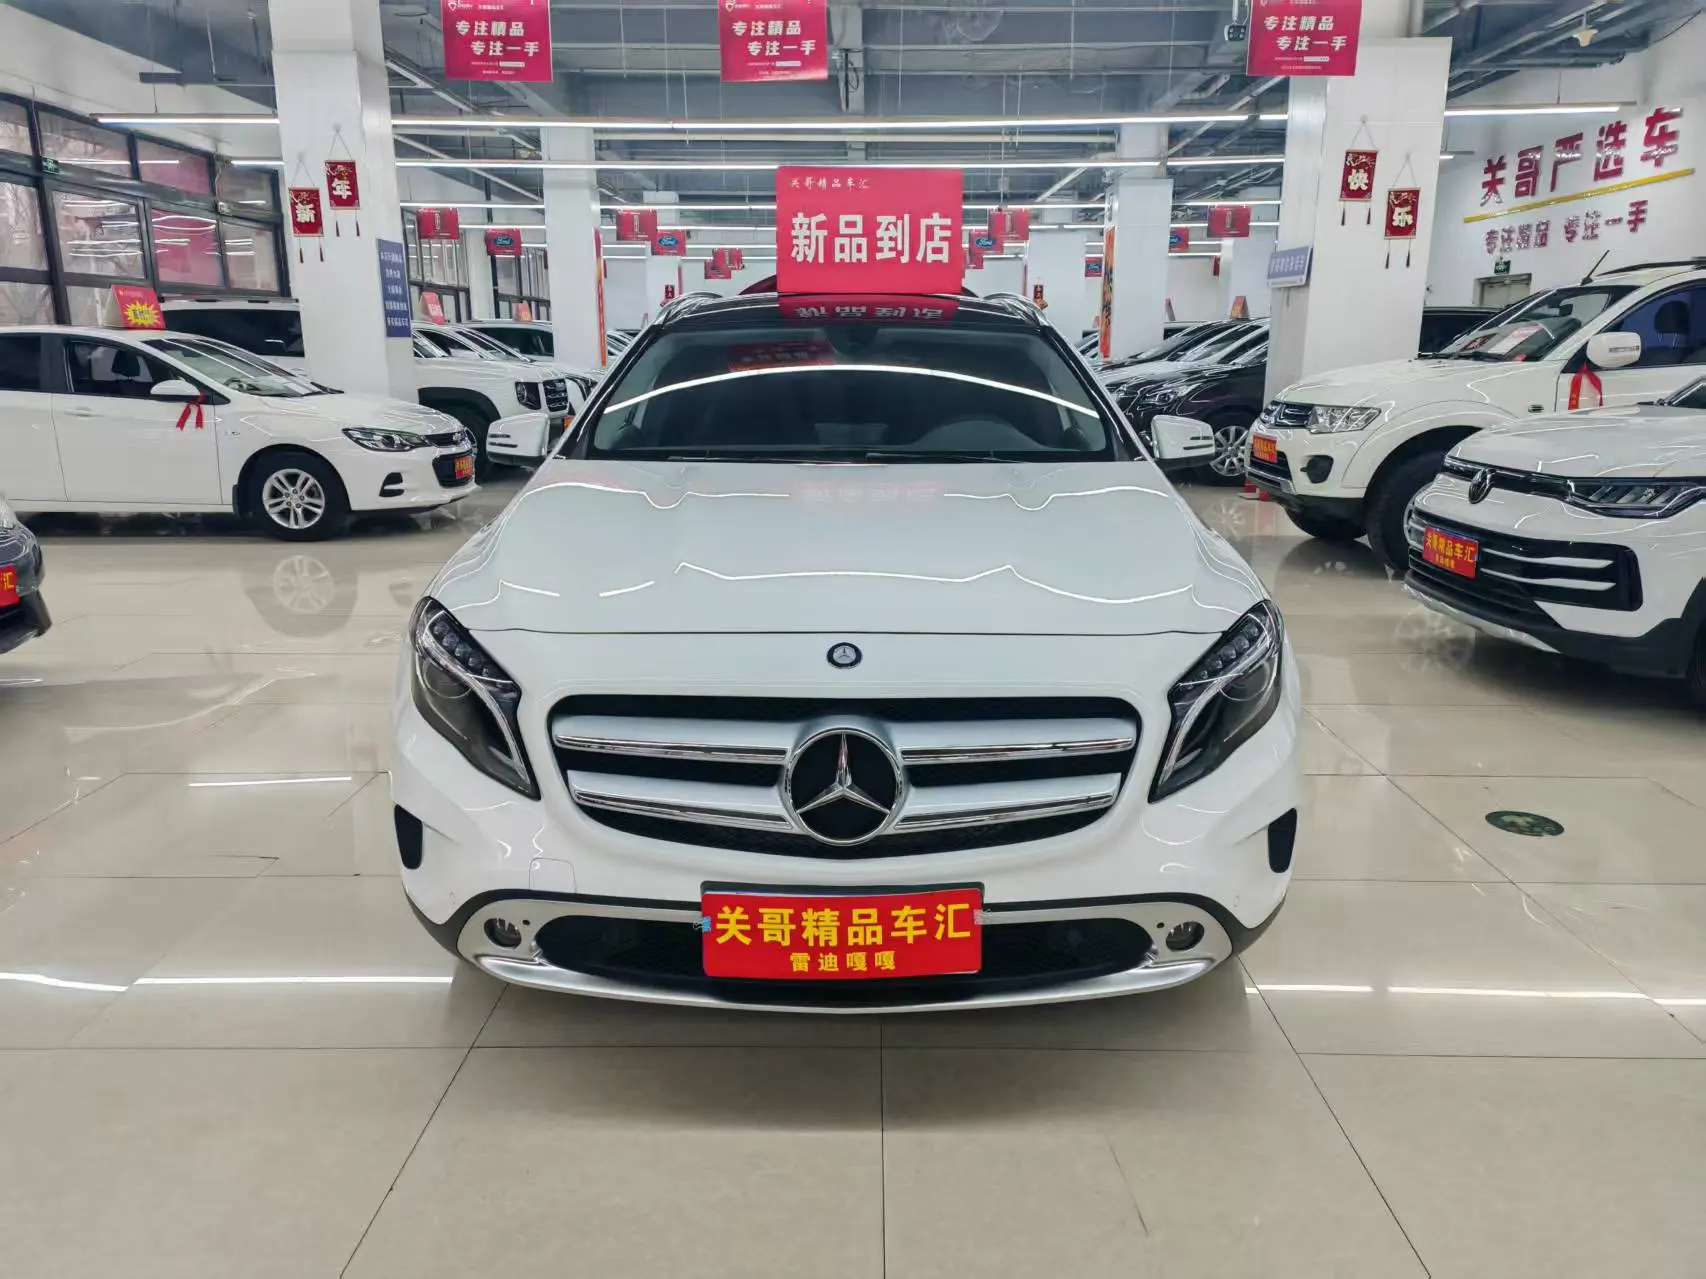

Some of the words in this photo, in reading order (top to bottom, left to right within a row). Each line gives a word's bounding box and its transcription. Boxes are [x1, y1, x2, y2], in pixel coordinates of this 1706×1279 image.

[732, 20, 802, 36] 专注精品
[1263, 15, 1334, 31] 专注精品
[470, 40, 540, 57] 专注一手
[747, 39, 817, 56] 专注一手
[1276, 35, 1348, 51] 专注一手
[1480, 106, 1683, 207] 关哥严选车
[331, 178, 353, 200] 年
[1347, 168, 1369, 191] 快
[295, 202, 316, 223] 新
[1391, 205, 1414, 228] 乐
[1563, 200, 1649, 243] 专注一手
[790, 212, 952, 264] 新品到店
[715, 903, 972, 947] 关哥精品车汇
[790, 950, 896, 972] 雷迪嘎嘎
